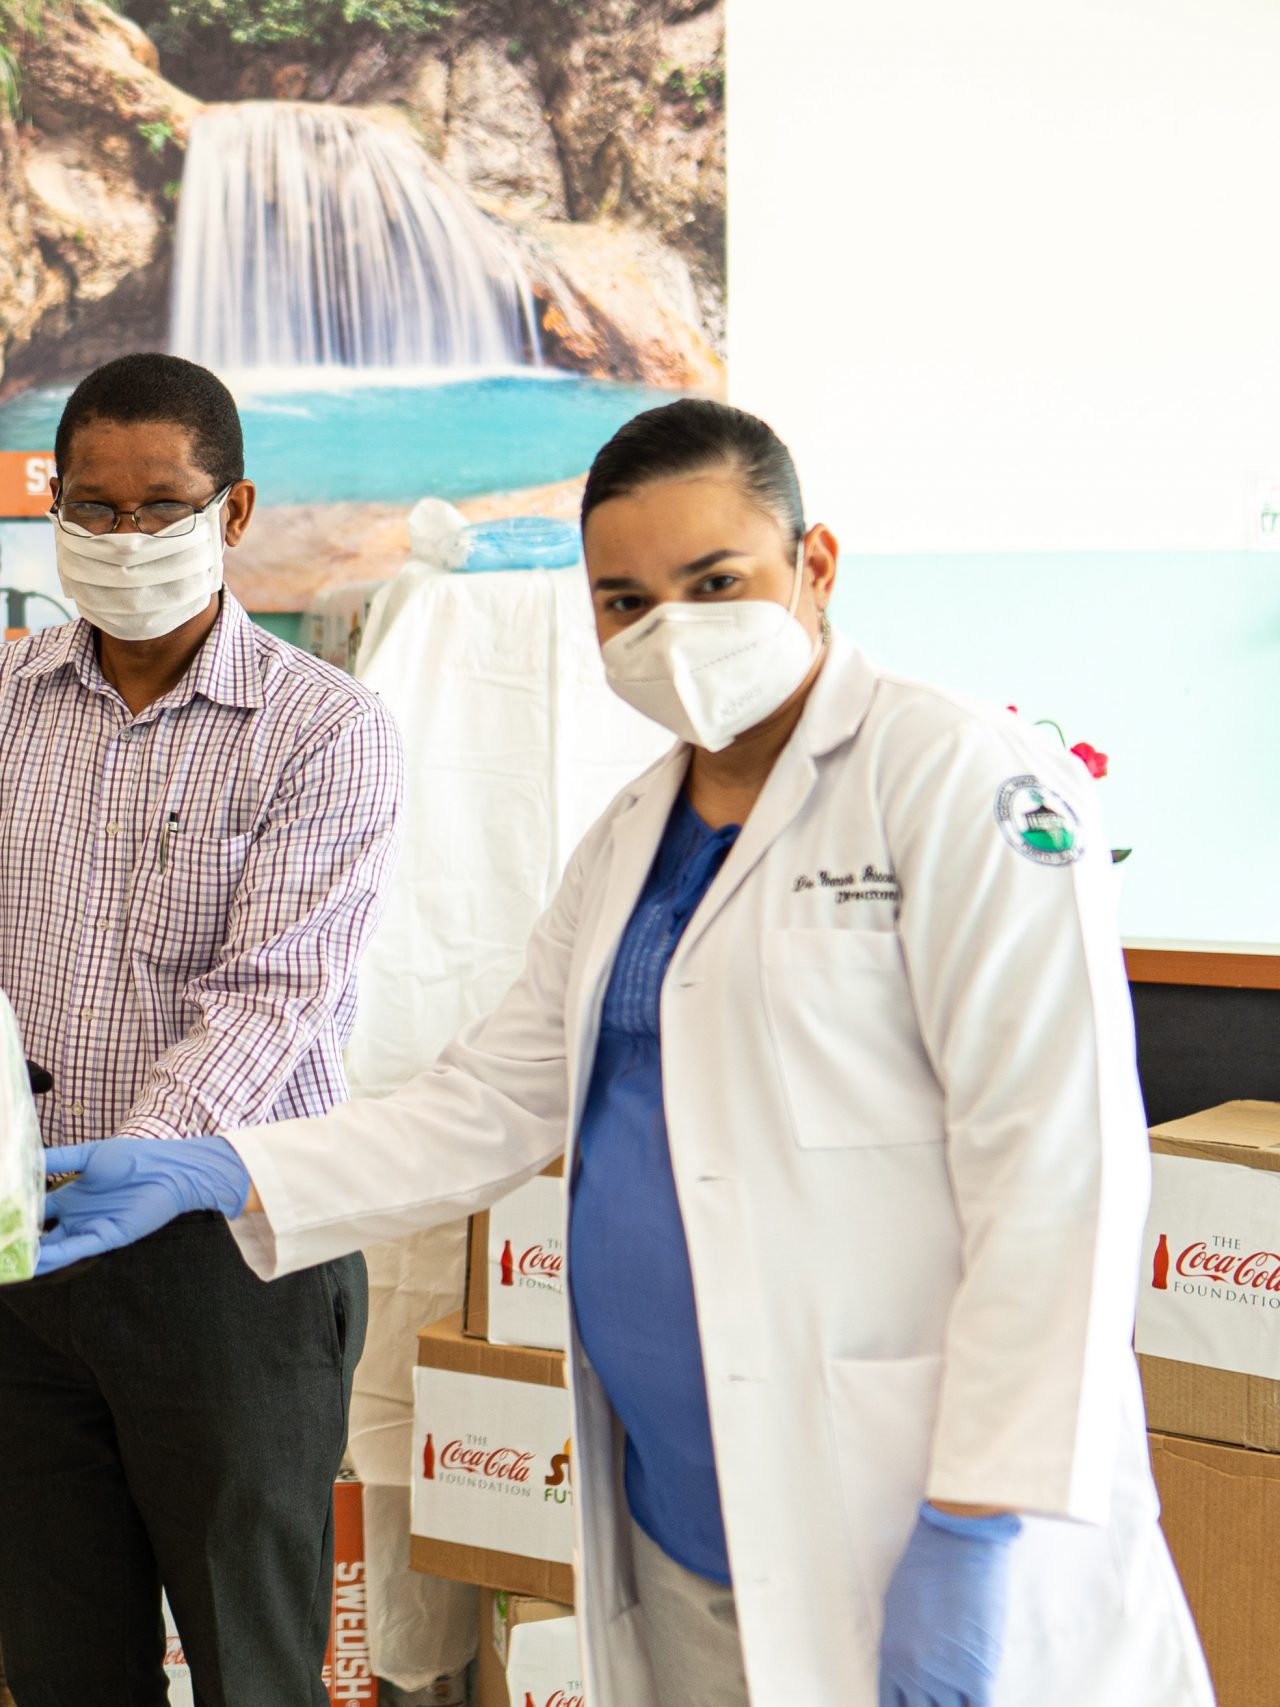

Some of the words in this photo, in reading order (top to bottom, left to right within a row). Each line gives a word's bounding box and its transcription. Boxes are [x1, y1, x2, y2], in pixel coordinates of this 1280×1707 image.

[1212, 1235, 1241, 1250] THE
[465, 1433, 488, 1447] THE
[440, 1439, 536, 1483] Coca-Cola
[438, 1472, 531, 1498] FOUNDATION
